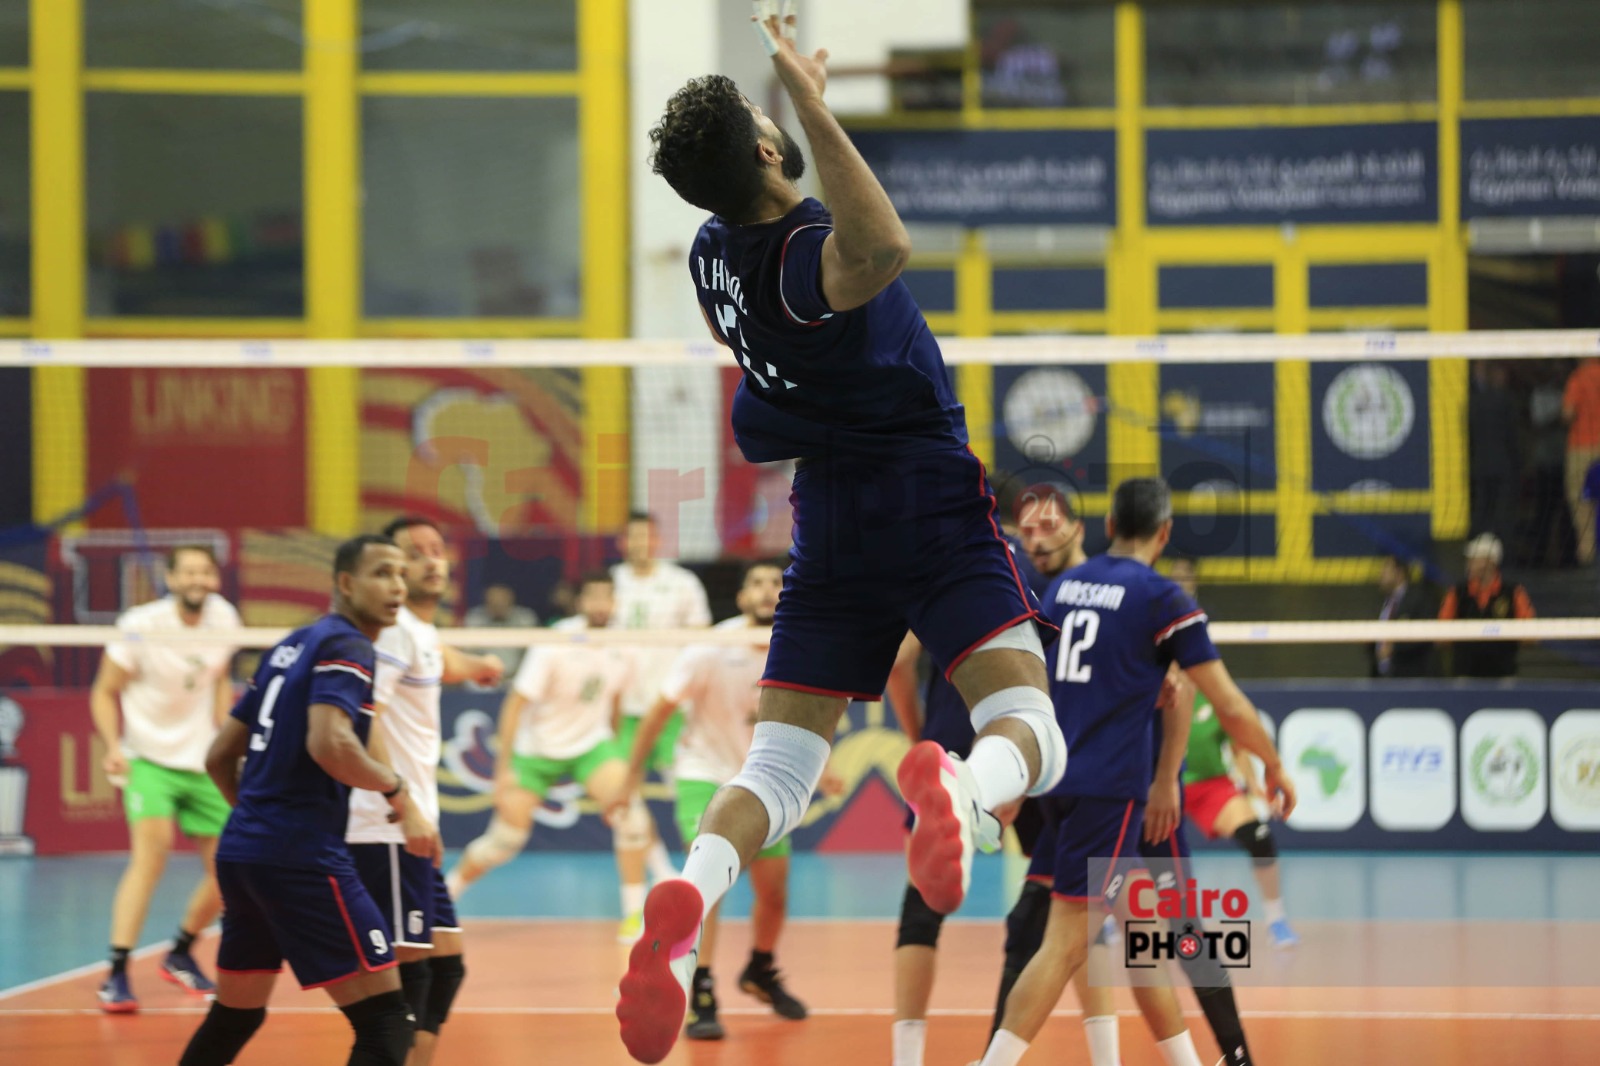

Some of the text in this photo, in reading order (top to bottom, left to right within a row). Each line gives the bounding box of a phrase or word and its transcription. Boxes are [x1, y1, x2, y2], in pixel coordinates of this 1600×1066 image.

[1055, 579, 1126, 611] HOSSAM
[1055, 609, 1100, 684] 12
[407, 909, 424, 935] 6
[368, 928, 389, 955] 9
